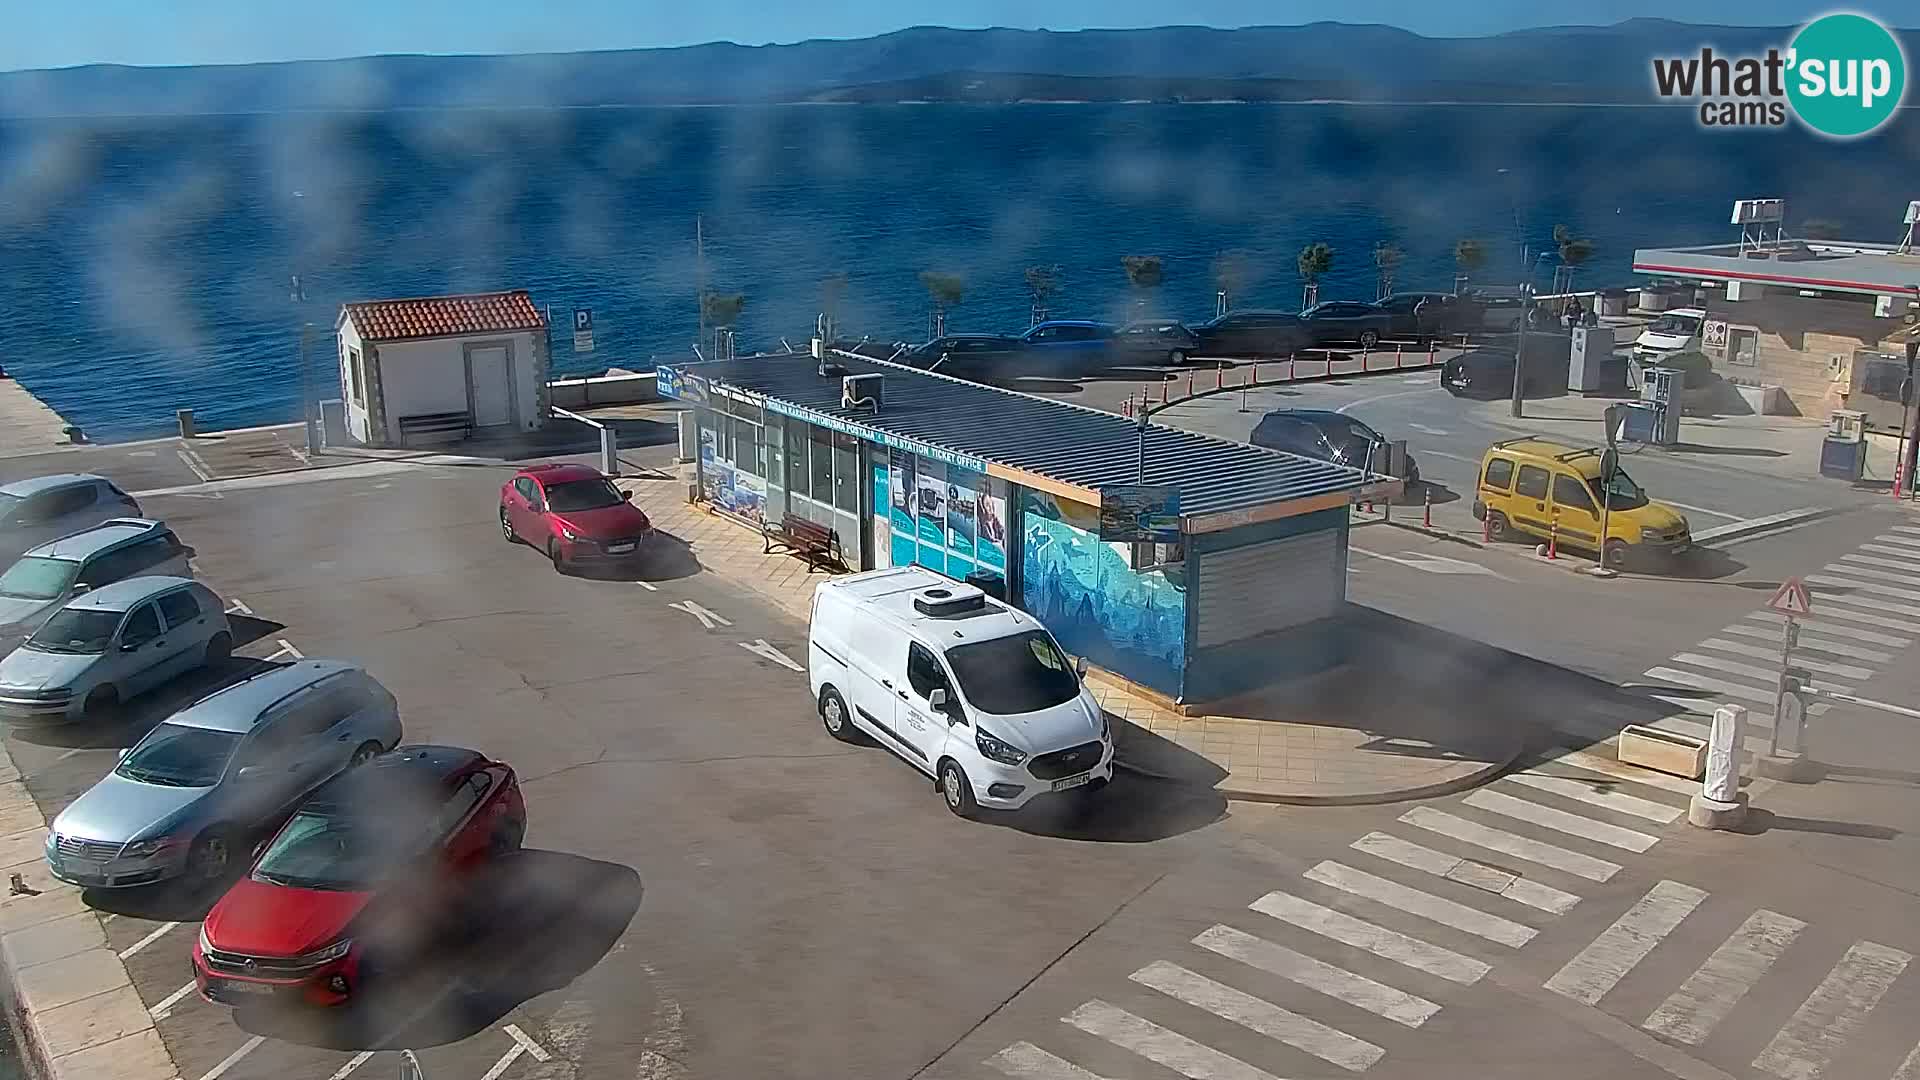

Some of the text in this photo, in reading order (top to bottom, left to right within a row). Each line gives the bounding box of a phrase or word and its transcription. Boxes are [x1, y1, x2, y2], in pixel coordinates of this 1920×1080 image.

[577, 311, 588, 329] P
[809, 412, 845, 431] AUTOBUSNA
[846, 423, 875, 440] POSTAJA
[884, 433, 898, 447] BUS
[899, 438, 929, 456] STATION
[931, 448, 956, 463] TICKET
[956, 455, 982, 471] OFFICE
